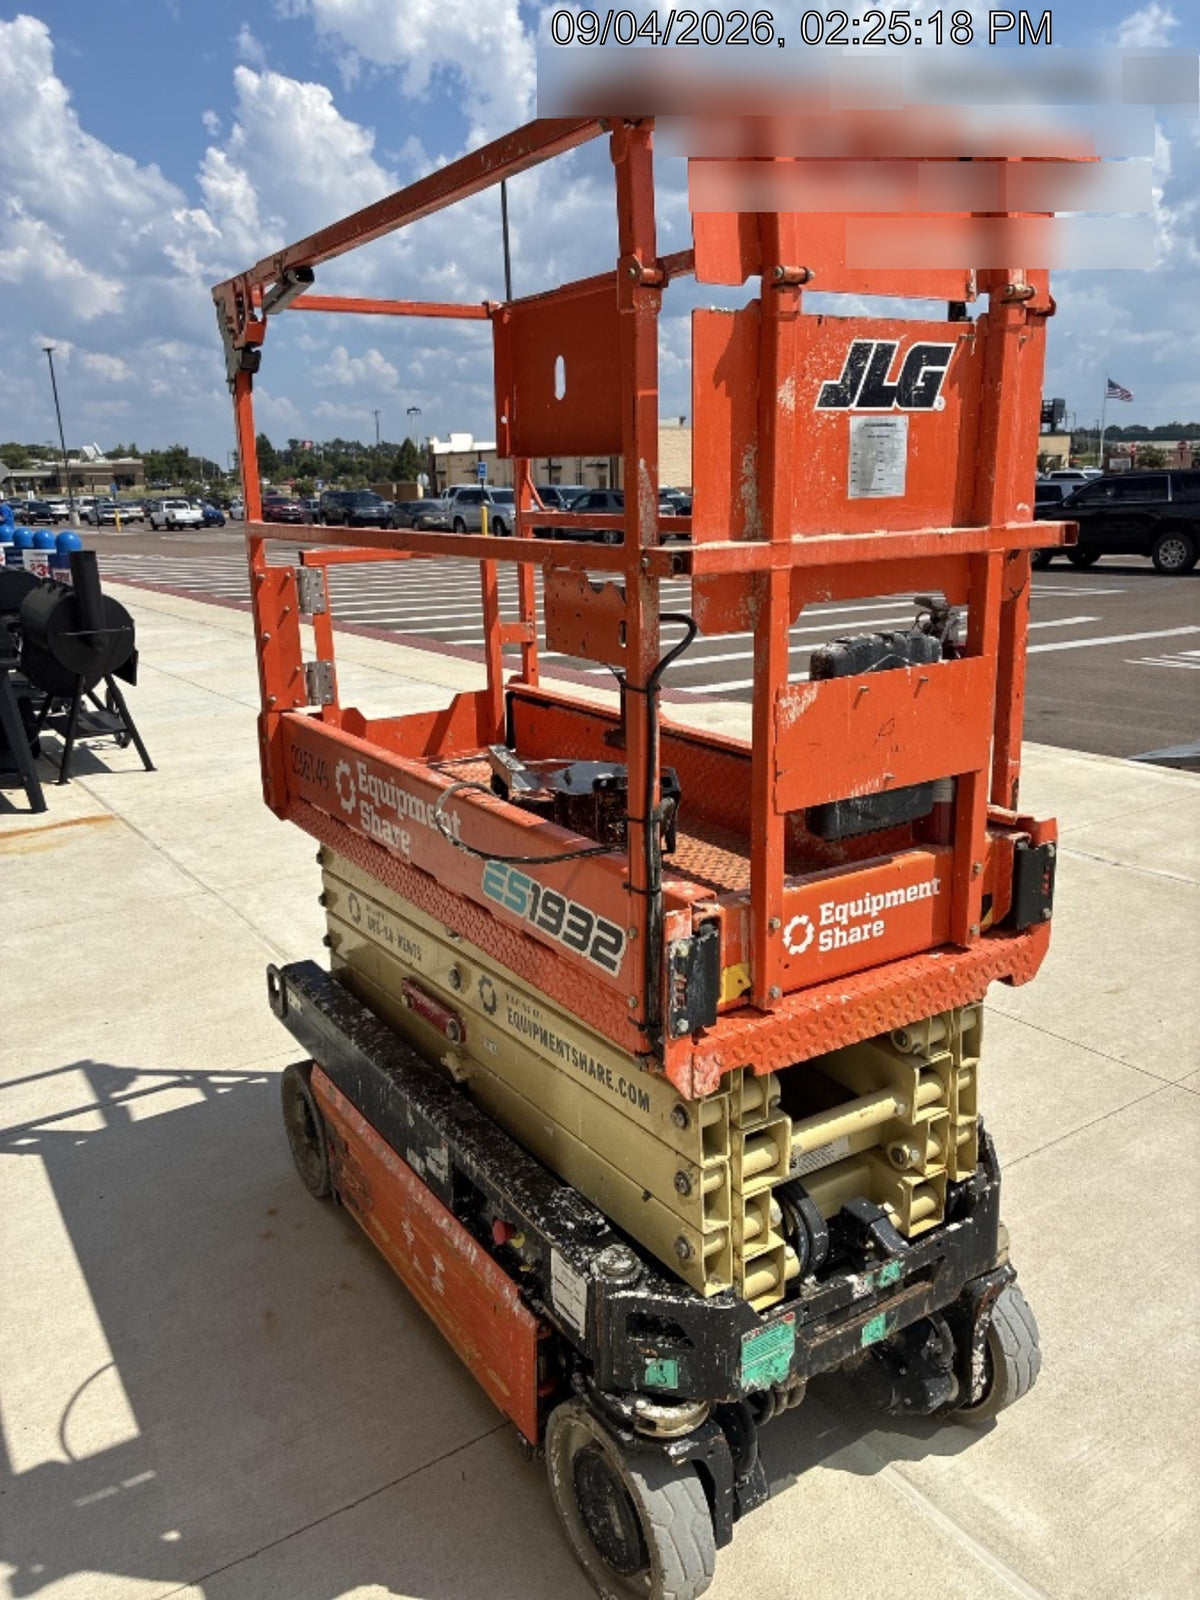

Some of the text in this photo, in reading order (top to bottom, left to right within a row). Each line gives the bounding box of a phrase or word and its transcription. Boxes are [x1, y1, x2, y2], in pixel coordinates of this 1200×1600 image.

[814, 338, 957, 411] JLG
[357, 761, 462, 841] Equipment
[361, 799, 411, 855] Share
[483, 859, 626, 978] ES1932
[818, 919, 885, 952] Share
[819, 877, 942, 926] Equipment
[507, 1006, 651, 1113] EQUIPMENTSHARE.COM
